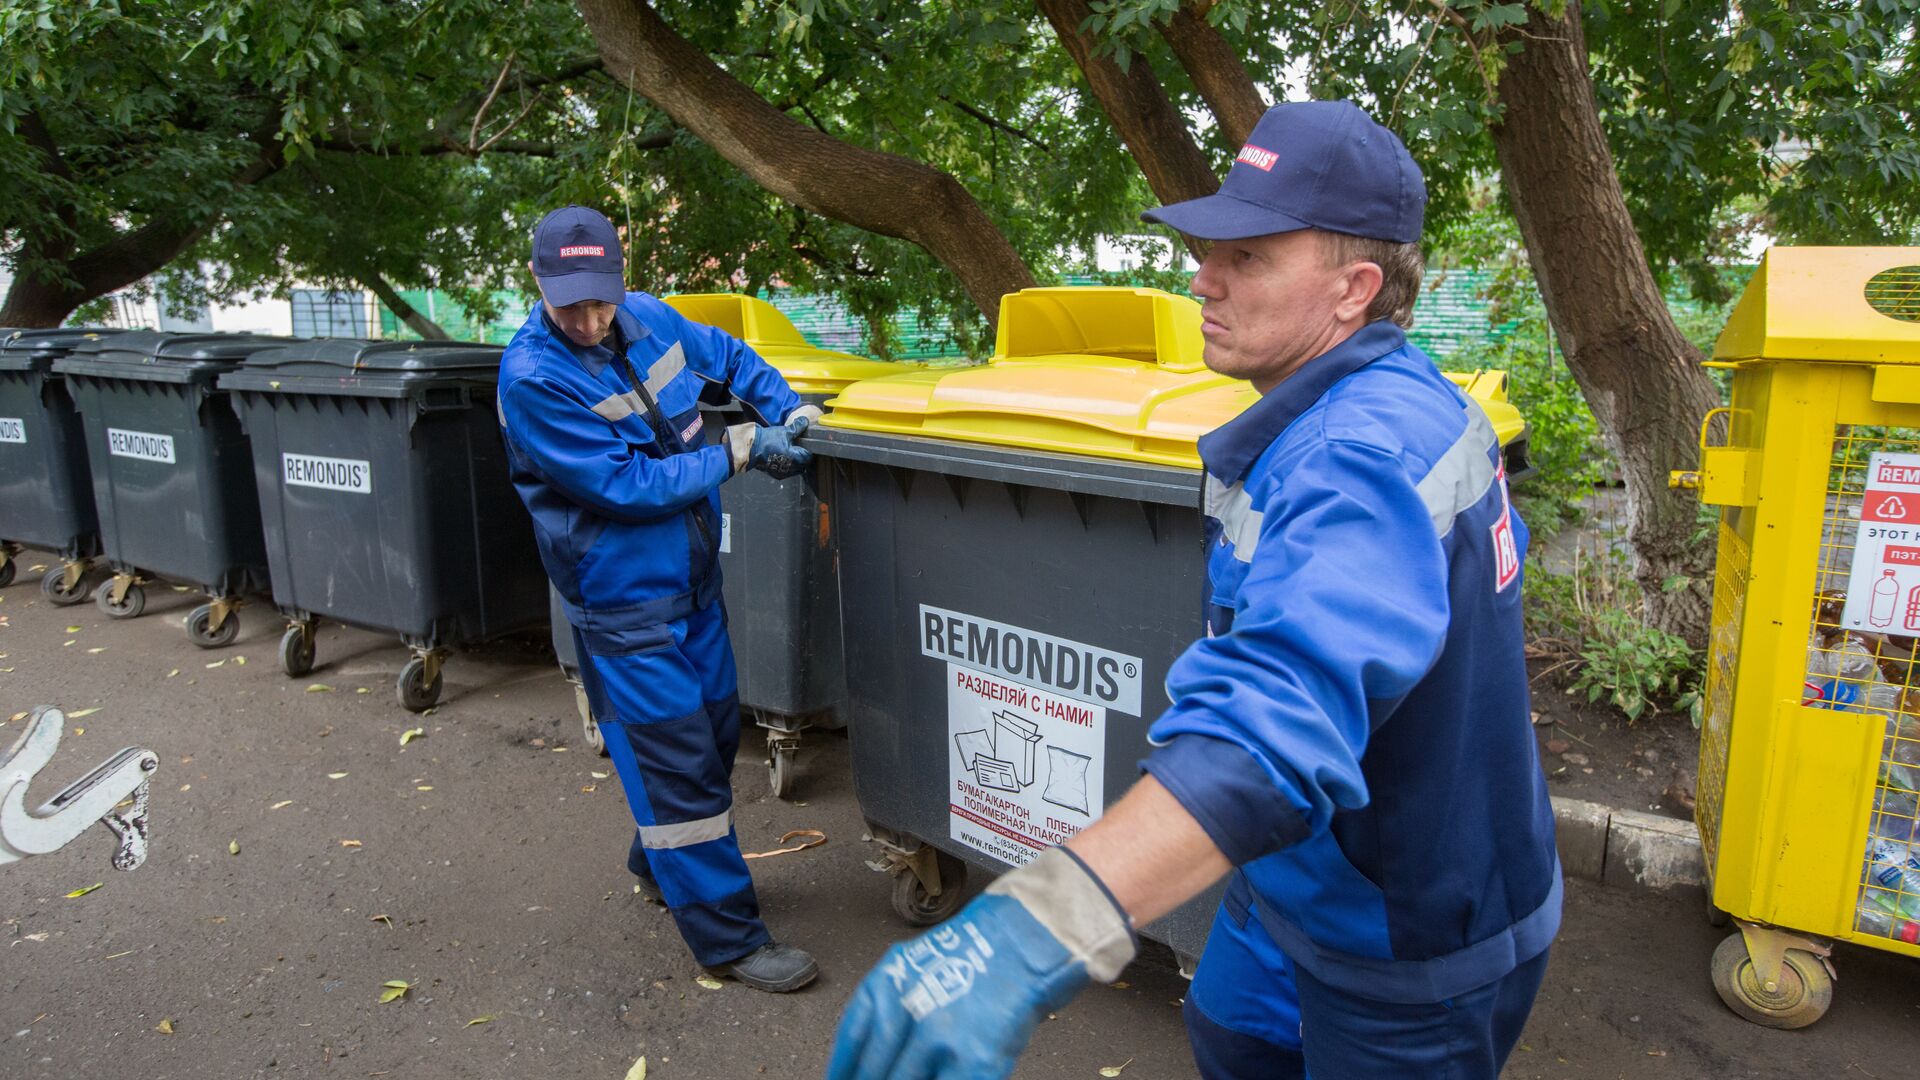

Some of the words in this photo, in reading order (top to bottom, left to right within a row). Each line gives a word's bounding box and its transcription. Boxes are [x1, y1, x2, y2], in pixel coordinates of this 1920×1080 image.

[1868, 528, 1909, 540] ЭТОТ
[957, 671, 1027, 709] РАЗДЕЛЯЙ
[1031, 694, 1041, 713] С
[1045, 701, 1093, 728] НАМИ!
[957, 780, 1030, 820] БУМАГА/КАРТОН
[964, 795, 1025, 832] ПОЛИМЕРНАЯ
